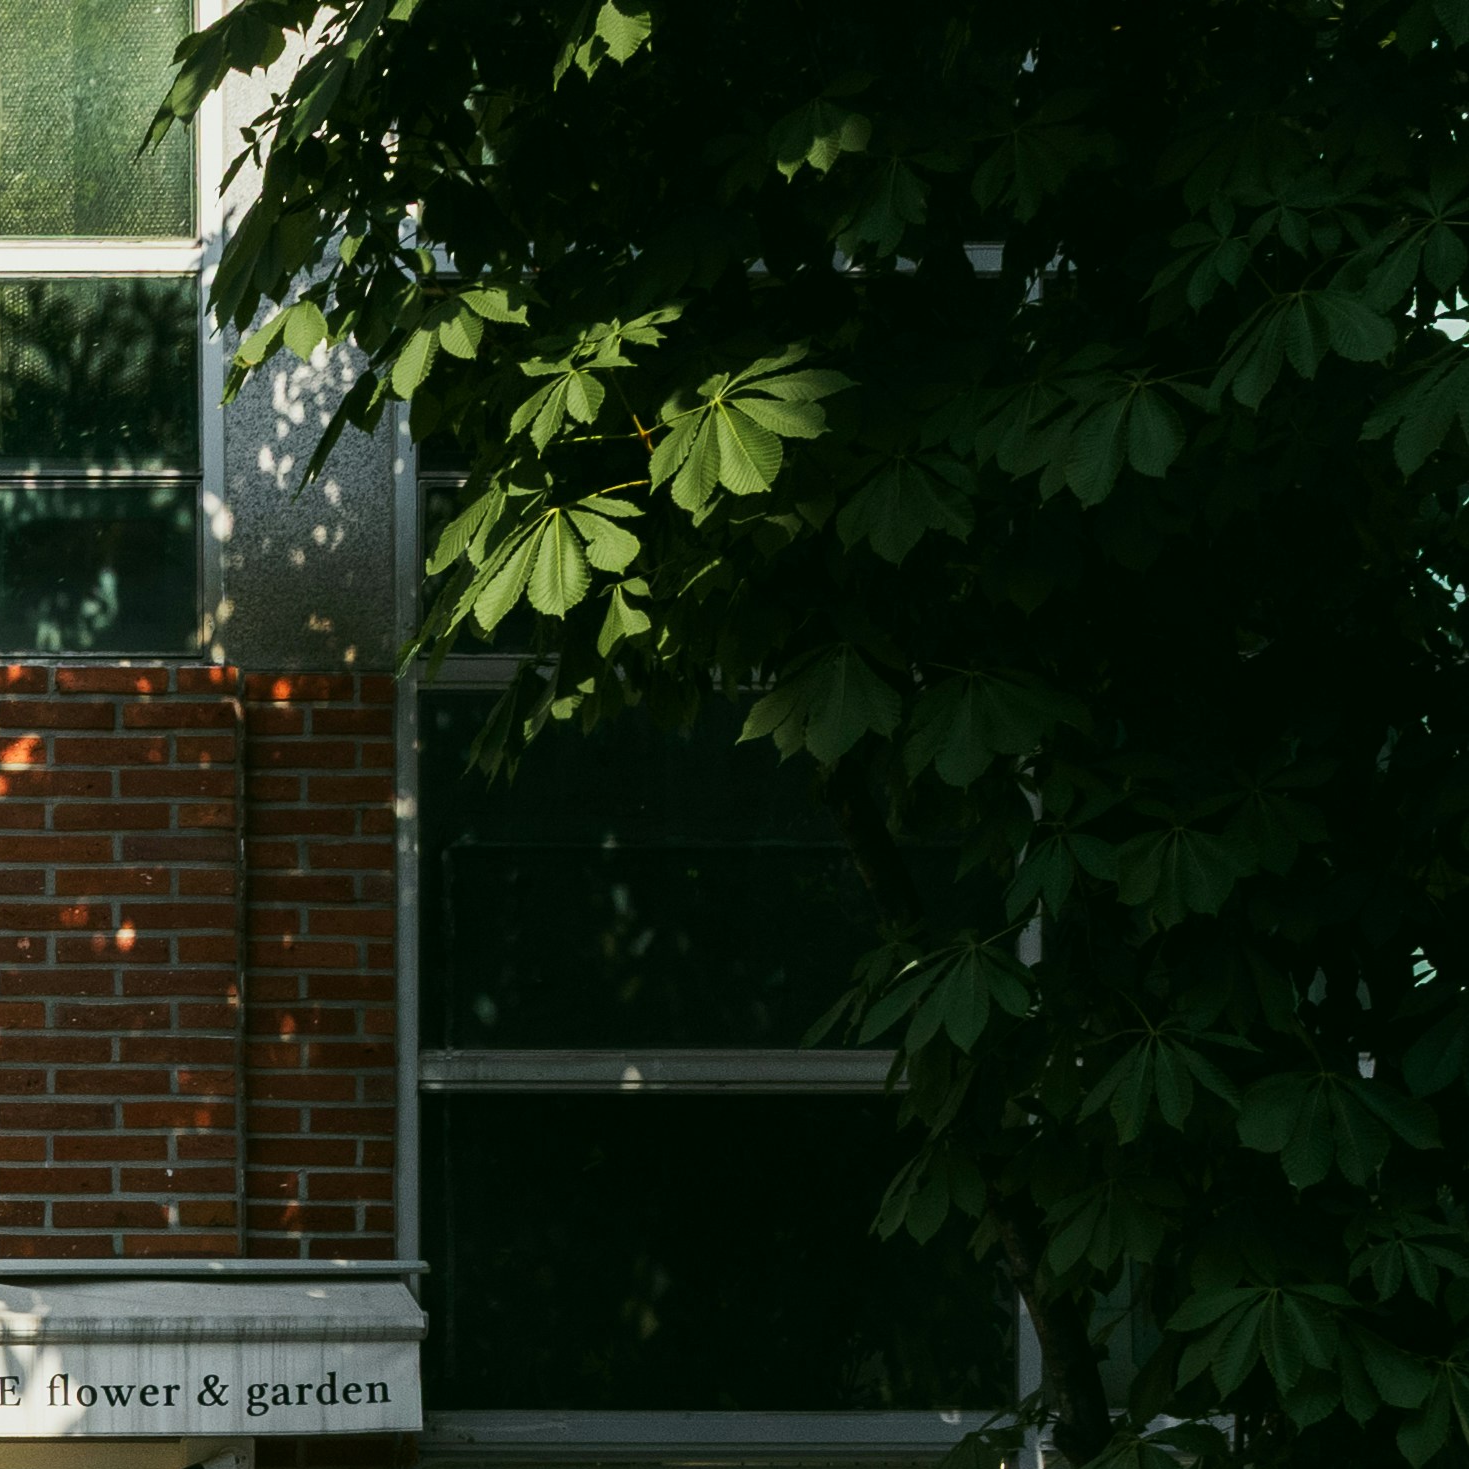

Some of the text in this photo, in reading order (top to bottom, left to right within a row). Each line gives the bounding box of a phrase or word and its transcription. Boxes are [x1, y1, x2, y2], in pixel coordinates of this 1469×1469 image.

[46, 1373, 181, 1408] flower
[196, 1373, 230, 1408] &
[246, 1371, 392, 1417] garden
